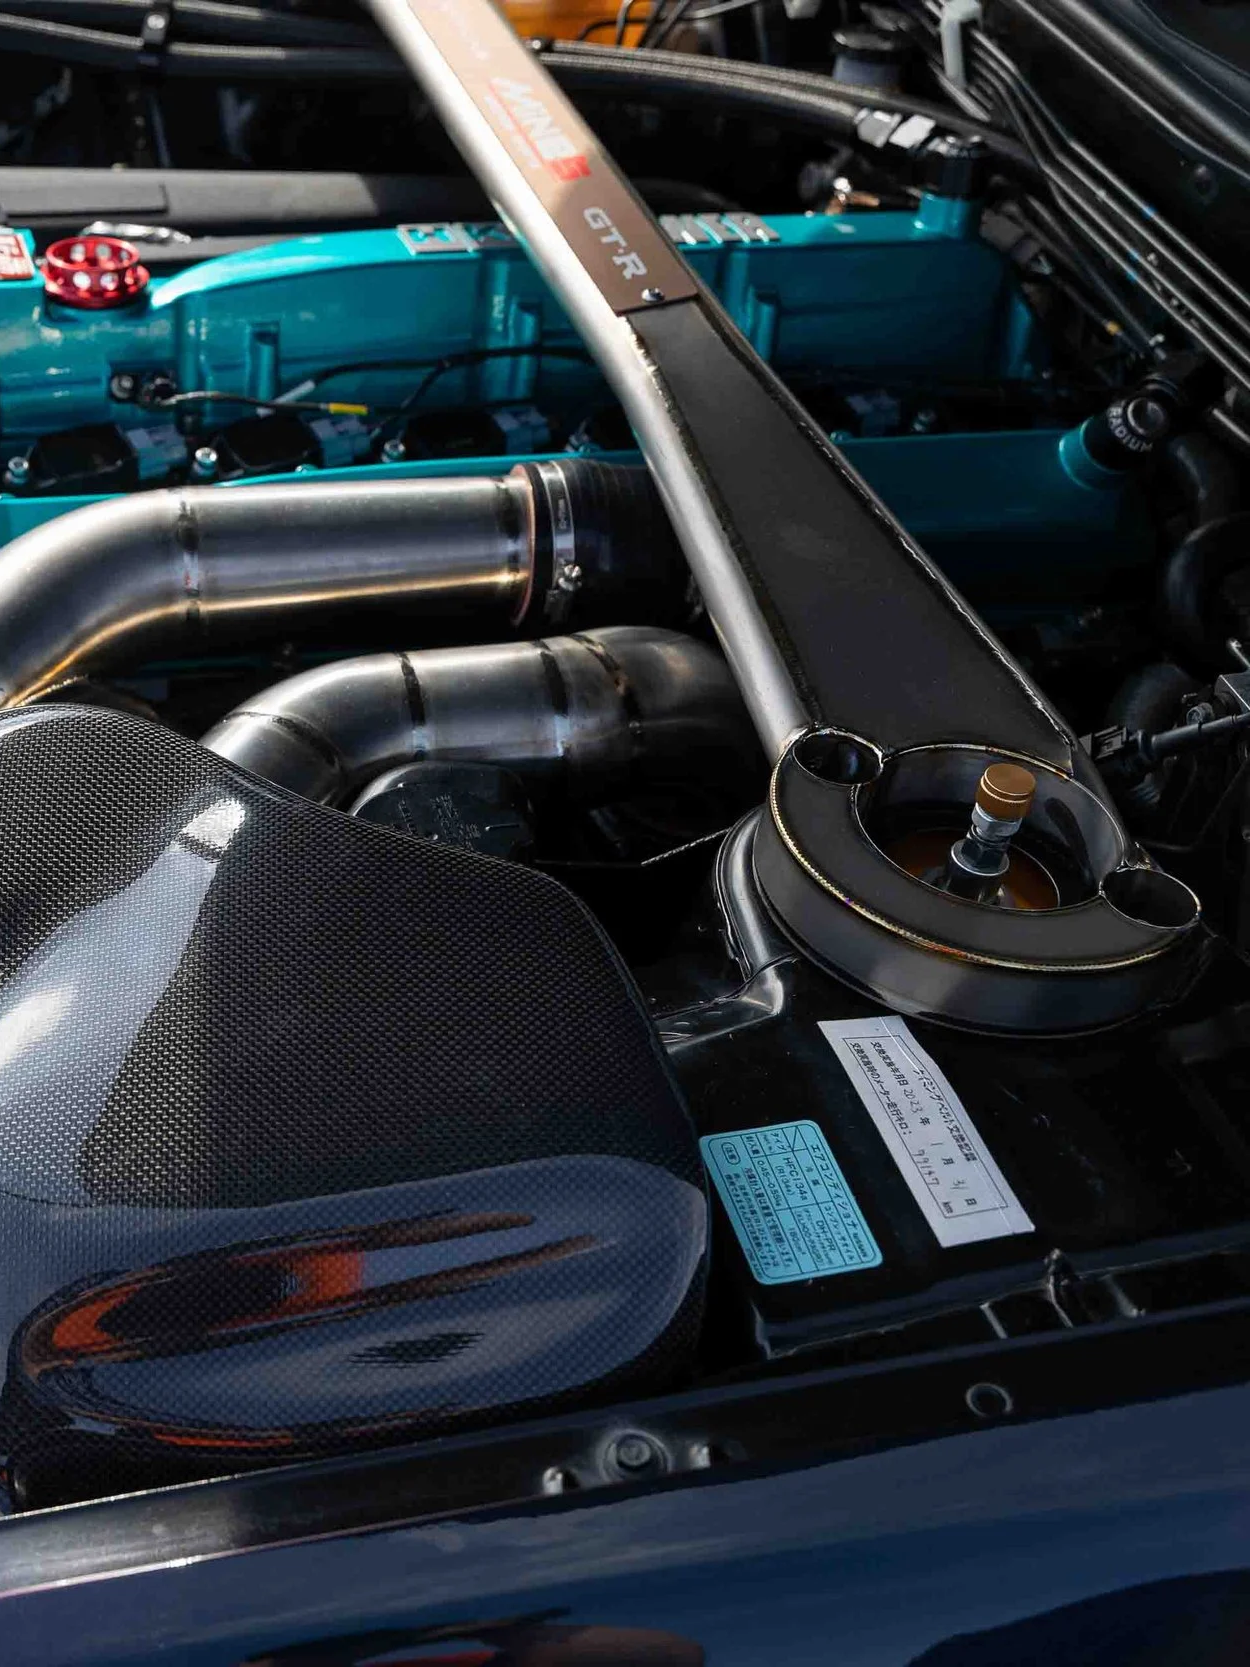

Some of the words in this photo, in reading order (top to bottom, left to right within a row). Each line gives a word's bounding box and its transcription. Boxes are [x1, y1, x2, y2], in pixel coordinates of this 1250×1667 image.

[810, 1144, 858, 1231] エアコンディショナ
